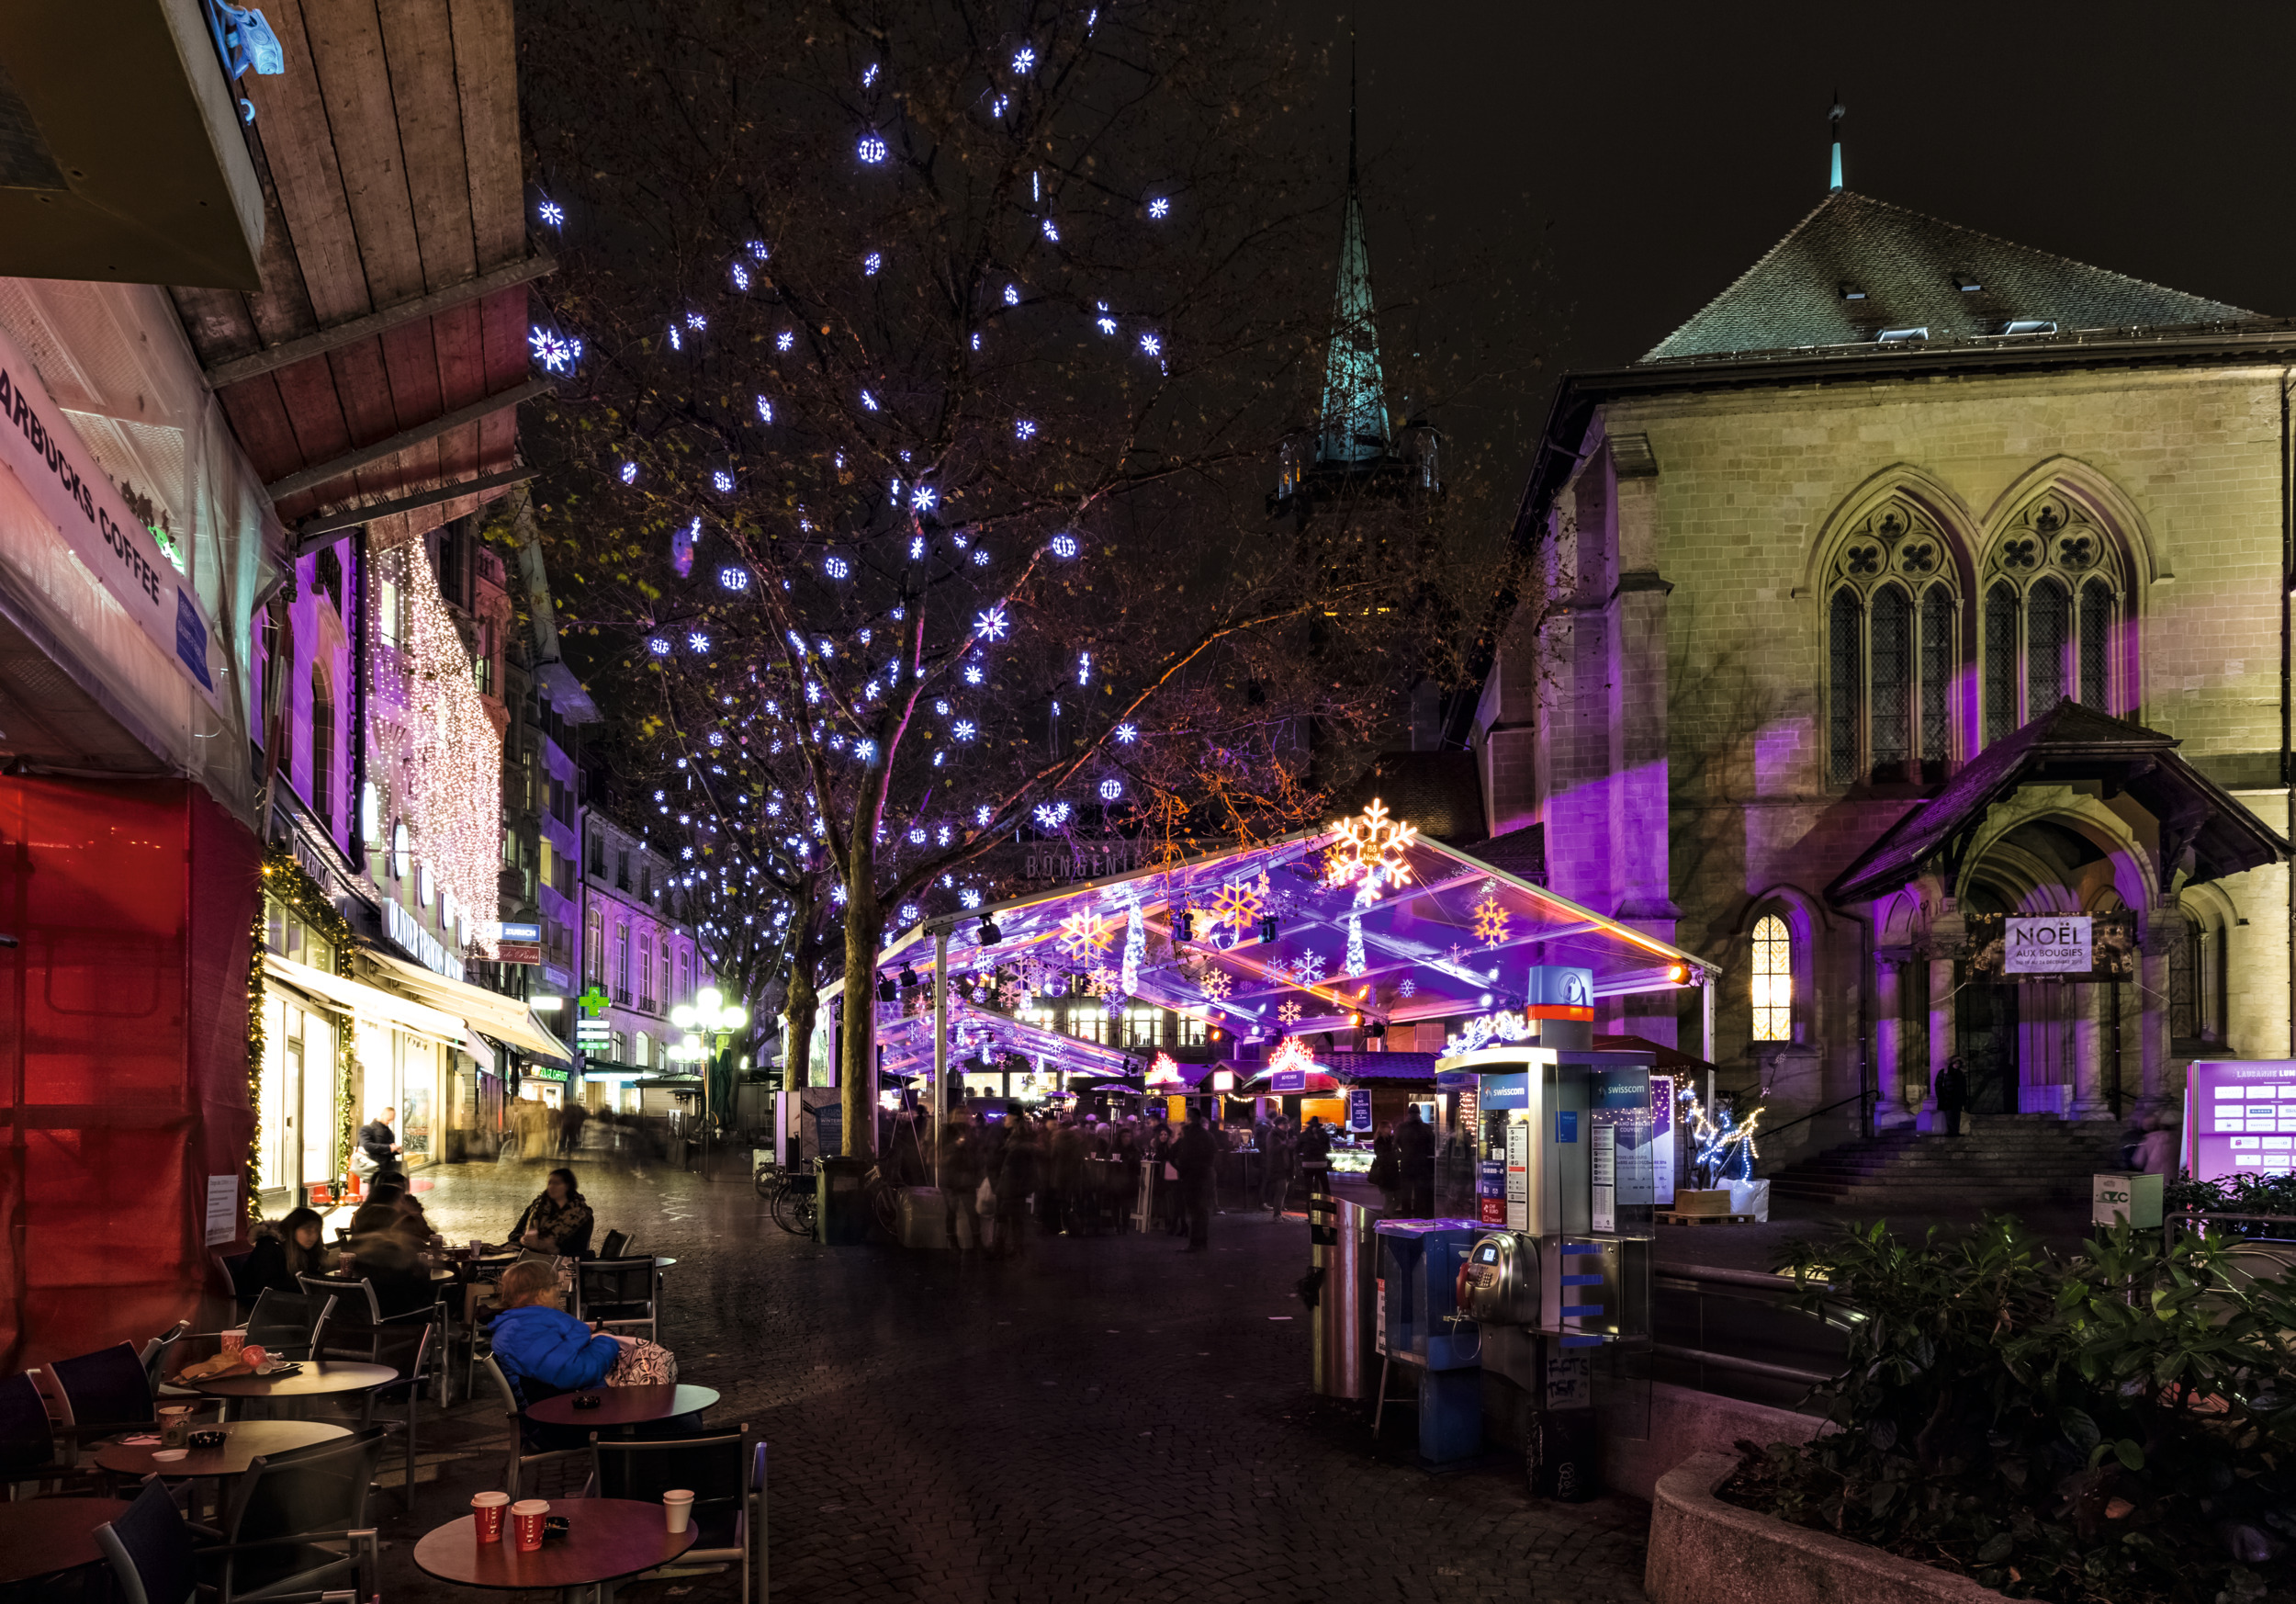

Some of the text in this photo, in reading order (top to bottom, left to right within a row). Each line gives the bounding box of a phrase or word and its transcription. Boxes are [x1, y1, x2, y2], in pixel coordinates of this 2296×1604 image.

[99, 506, 161, 606] COFFEE
[504, 928, 536, 937] ZURICH
[2016, 921, 2083, 946] NOËL
[2016, 948, 2083, 957] AUX BOUGIES
[2236, 1070, 2278, 1079] LAUSANNE
[1493, 1086, 1525, 1097] swisscom
[1607, 1084, 1645, 1094] swisscom
